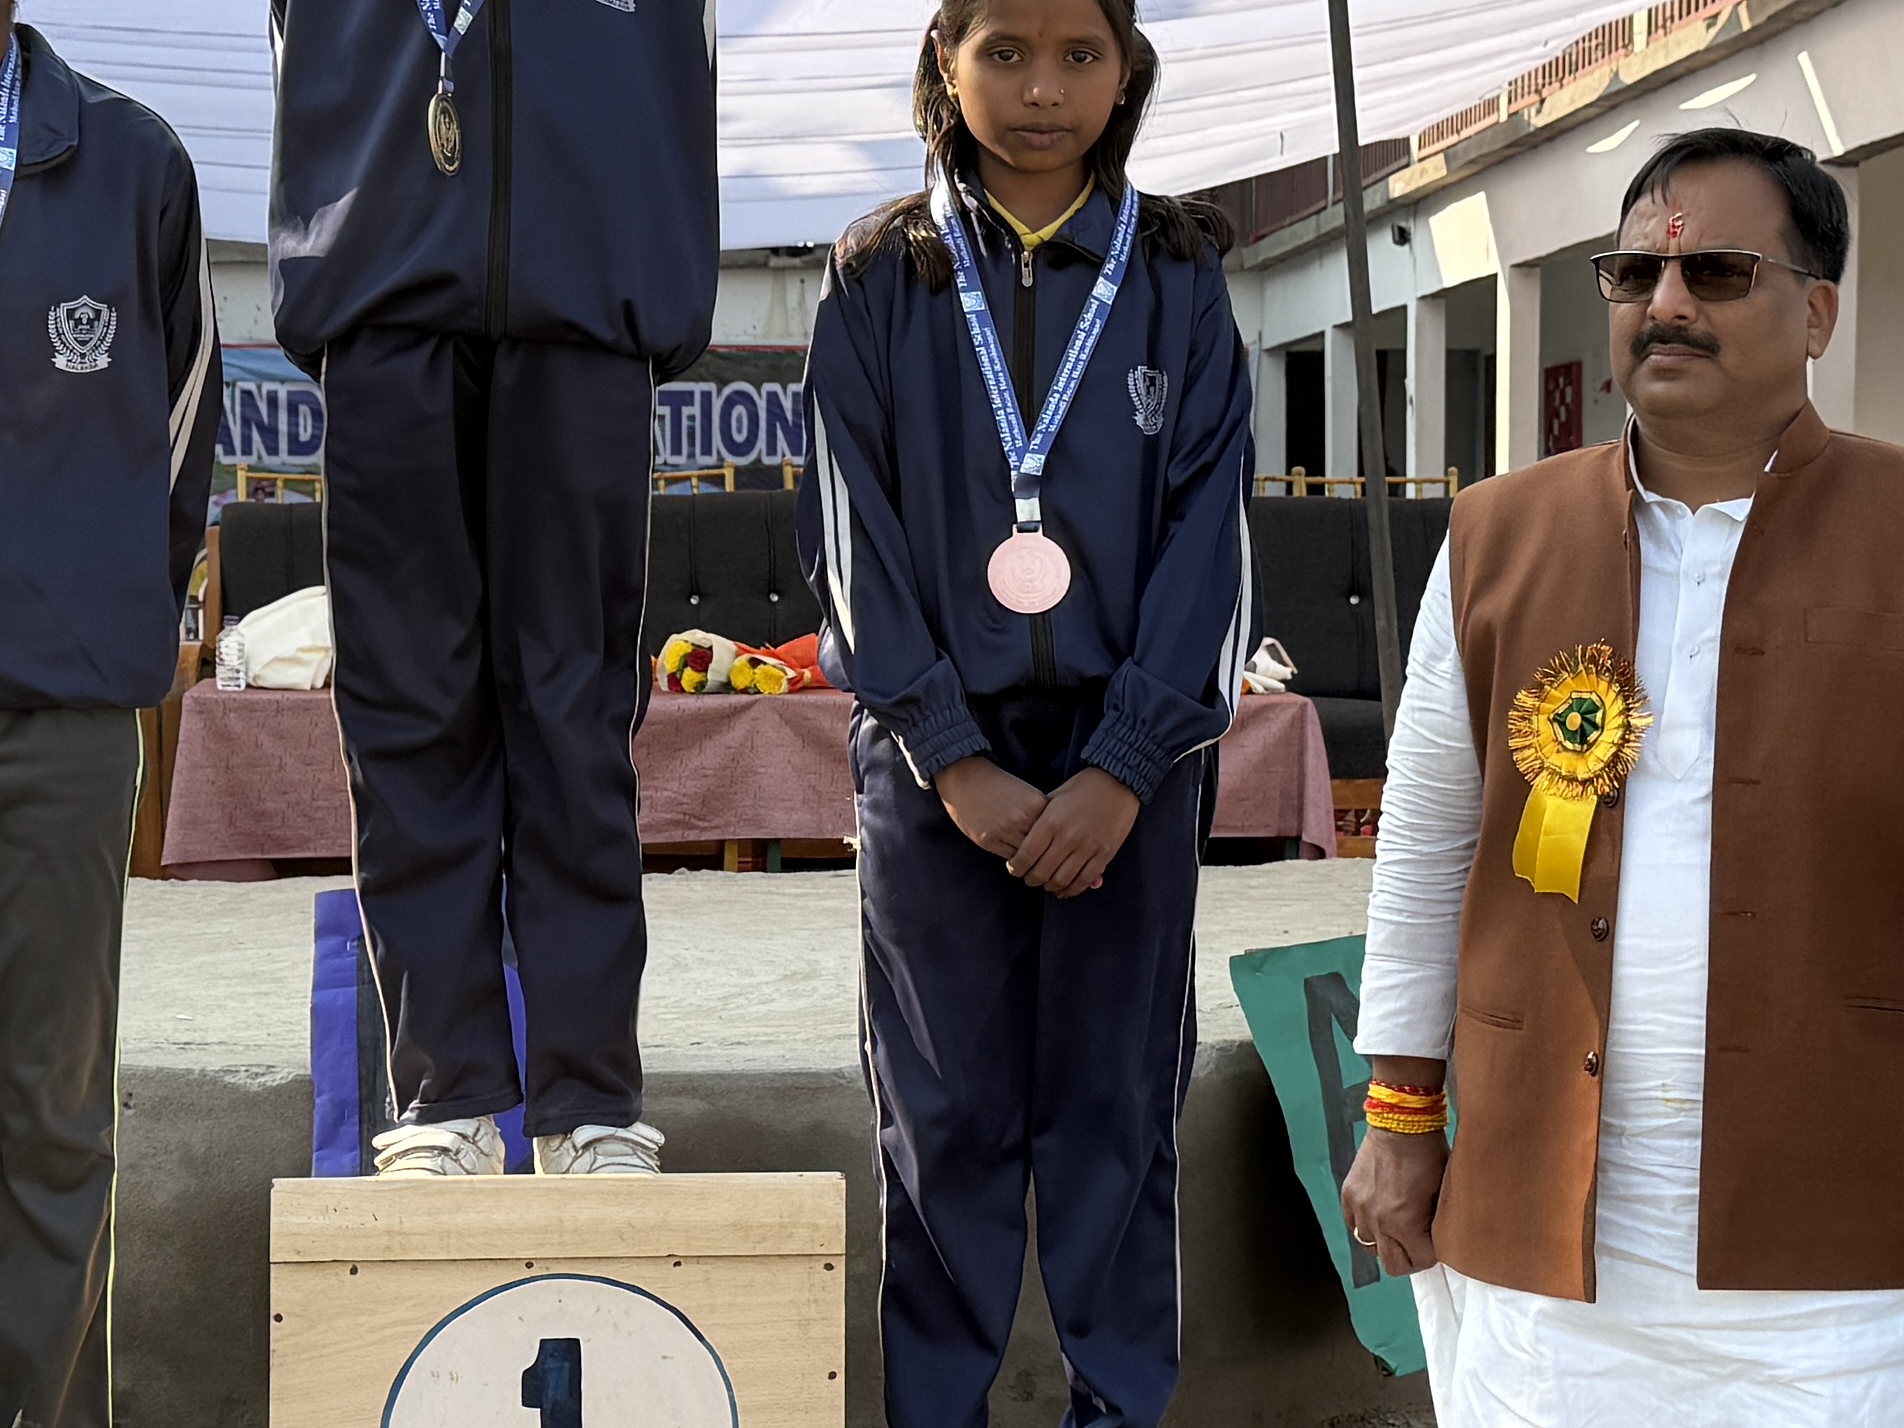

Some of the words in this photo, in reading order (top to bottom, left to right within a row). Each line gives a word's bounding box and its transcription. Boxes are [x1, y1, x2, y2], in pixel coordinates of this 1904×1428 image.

[425, 11, 437, 30] The
[1107, 222, 1128, 258] Nalanda
[954, 270, 967, 288] The
[1103, 256, 1117, 276] The
[966, 313, 983, 345] School
[1078, 297, 1101, 330] School
[1051, 329, 1088, 392] International
[975, 345, 1002, 409] International
[1036, 391, 1061, 432] Nalanda
[993, 409, 1014, 451] Nalanda
[1029, 432, 1044, 451] The
[1006, 450, 1020, 468] The
